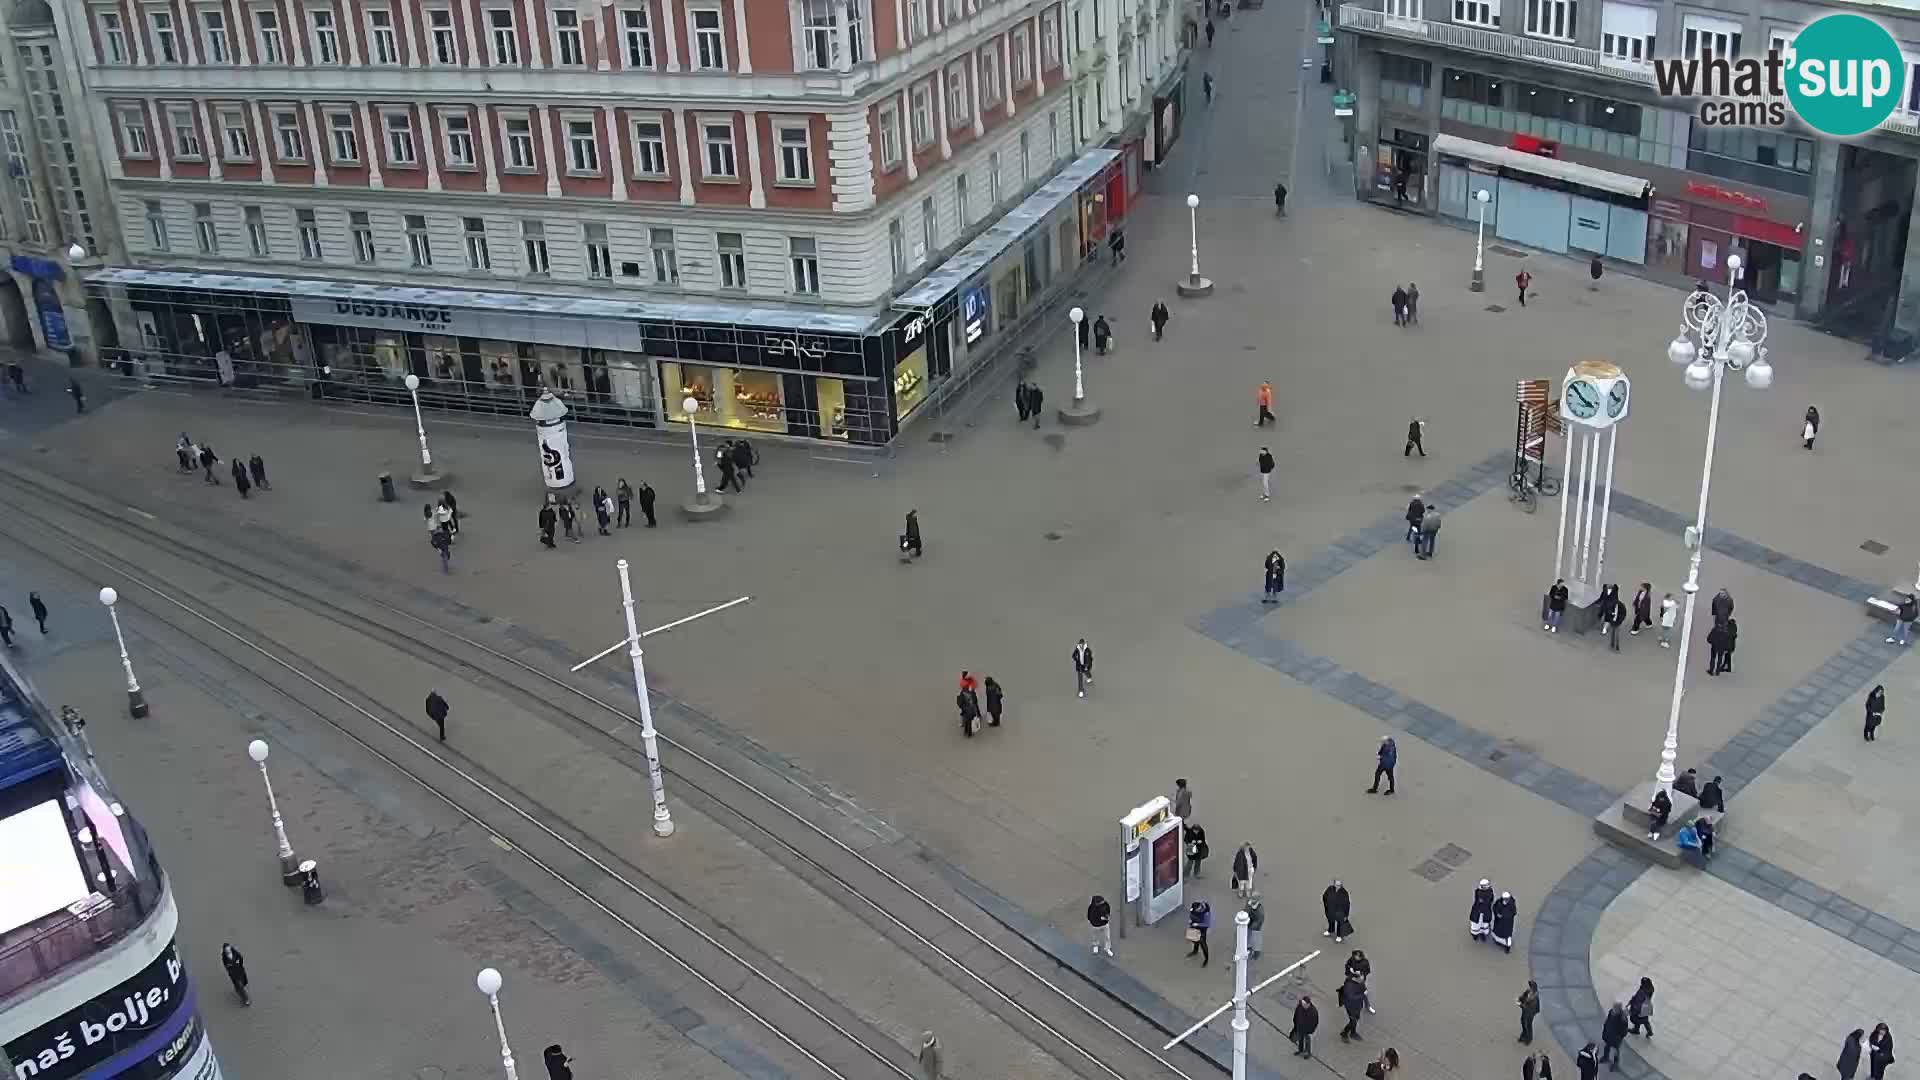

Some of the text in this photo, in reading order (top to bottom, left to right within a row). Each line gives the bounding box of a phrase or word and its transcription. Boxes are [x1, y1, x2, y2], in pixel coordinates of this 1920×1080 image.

[336, 302, 452, 323] DESSANGE
[15, 1031, 76, 1080] naš
[80, 987, 169, 1046] bolje,
